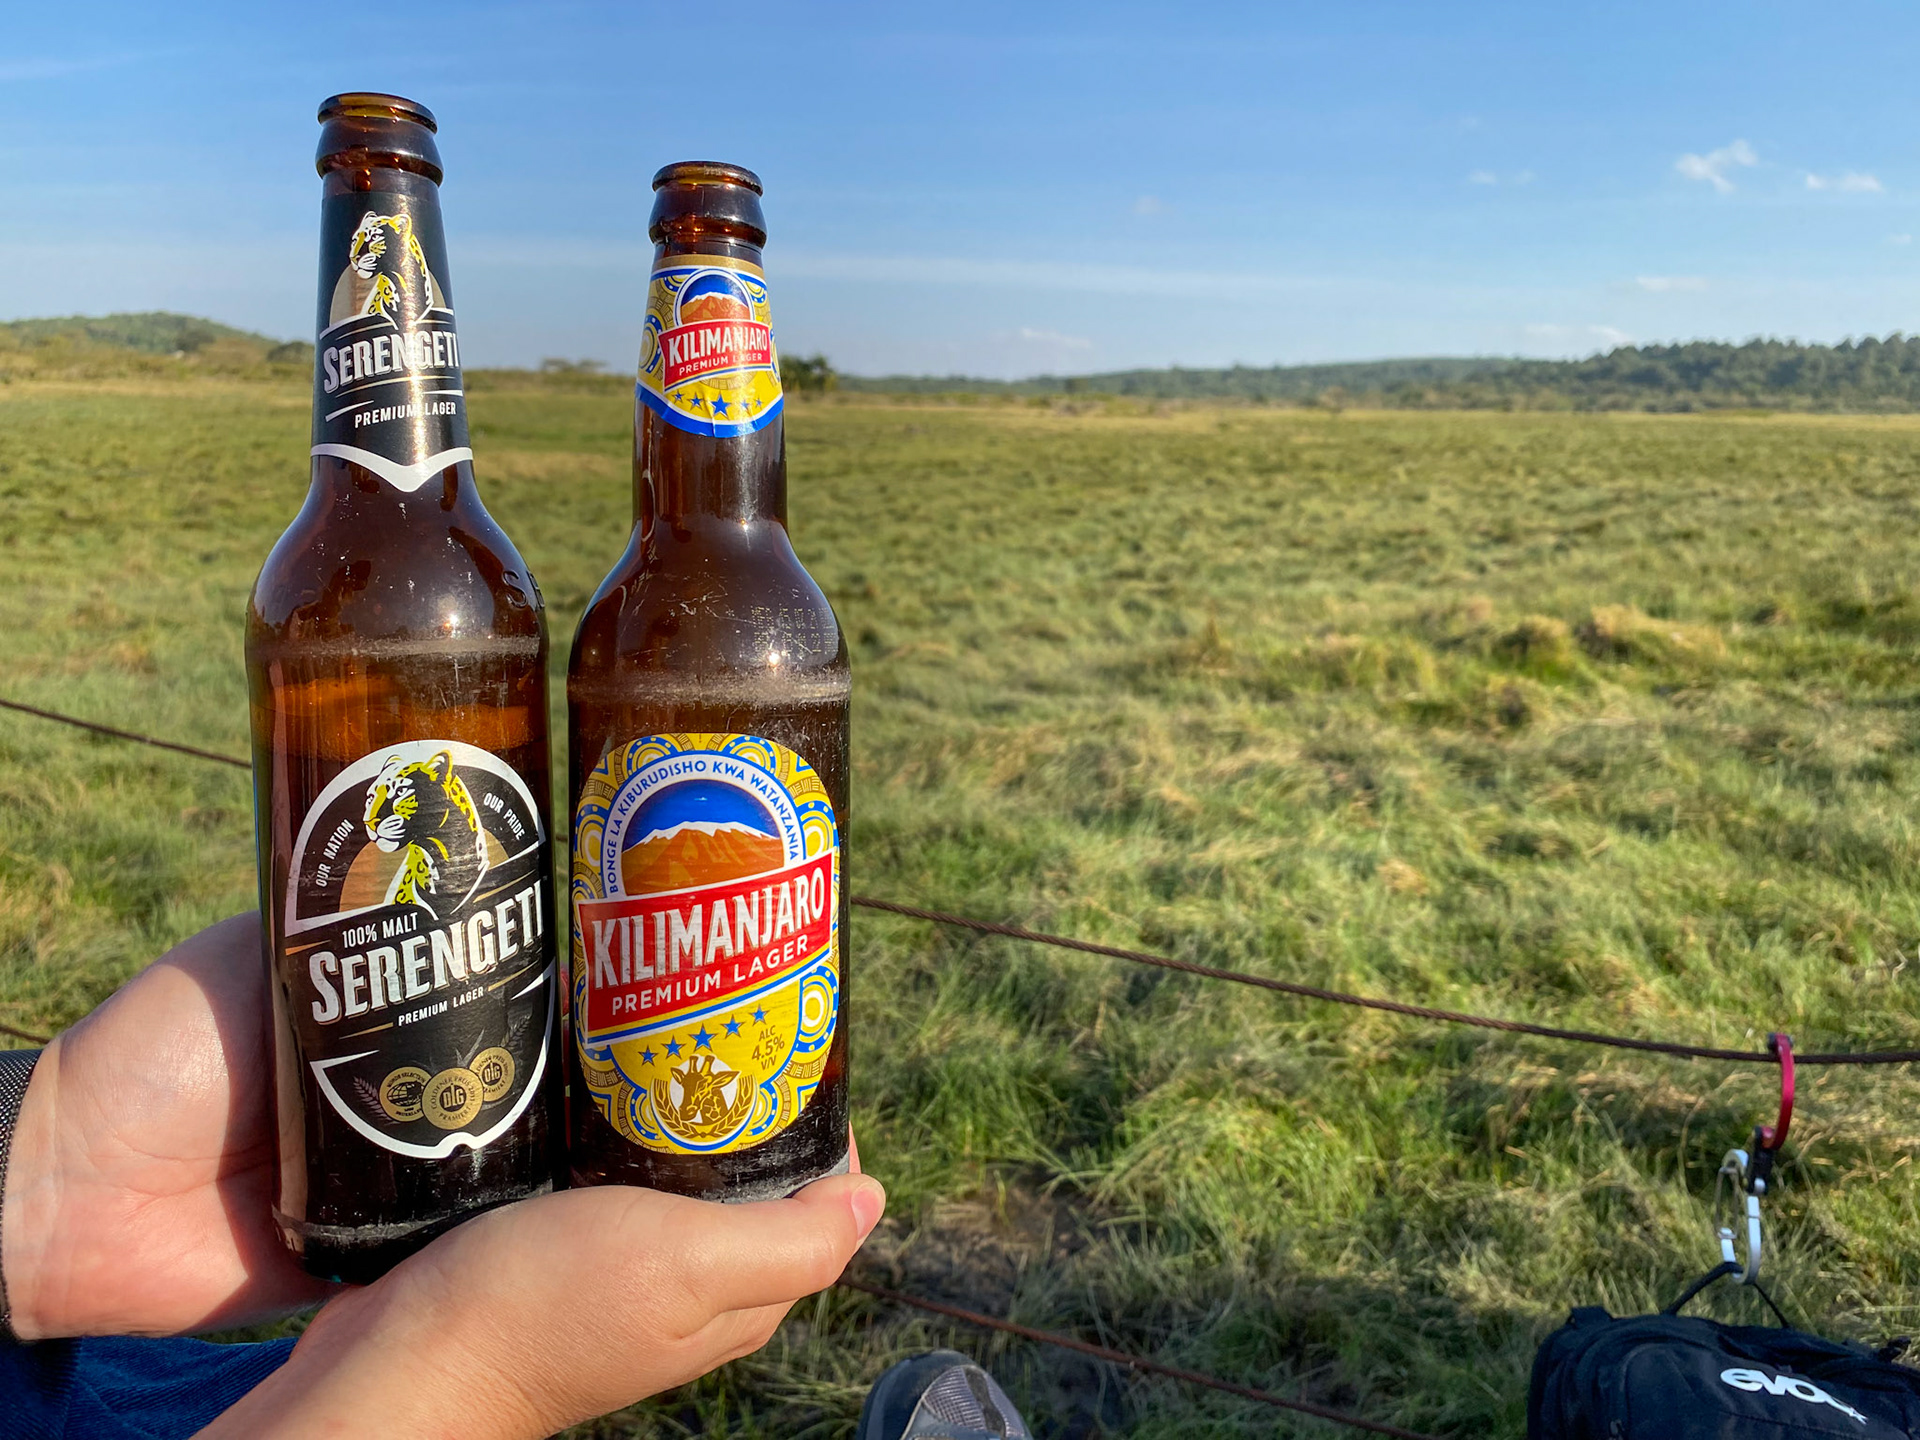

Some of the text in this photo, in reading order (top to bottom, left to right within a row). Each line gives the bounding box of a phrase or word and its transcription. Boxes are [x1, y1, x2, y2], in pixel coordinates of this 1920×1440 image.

[323, 331, 460, 394] SERENGETI
[668, 326, 768, 367] KILIMANJARO
[679, 354, 729, 376] PREMIUM
[354, 401, 457, 428] PREMIUM LAGER
[483, 792, 527, 841] OUR PRIDE
[603, 760, 800, 894] BONGE LA KIBURUDISHO KWA WATANZANIA
[315, 818, 355, 888] OUR NATION
[342, 912, 418, 949] 100% MALT
[592, 867, 825, 990] KILIMANJARO
[308, 881, 544, 1026] SERENGETI
[612, 935, 808, 1015] PREMIUM LAGER
[398, 987, 484, 1027] PREMIUM LAGER
[751, 1033, 785, 1060] 4.5%
[758, 1025, 776, 1042] ALC
[761, 1055, 777, 1071] V/V
